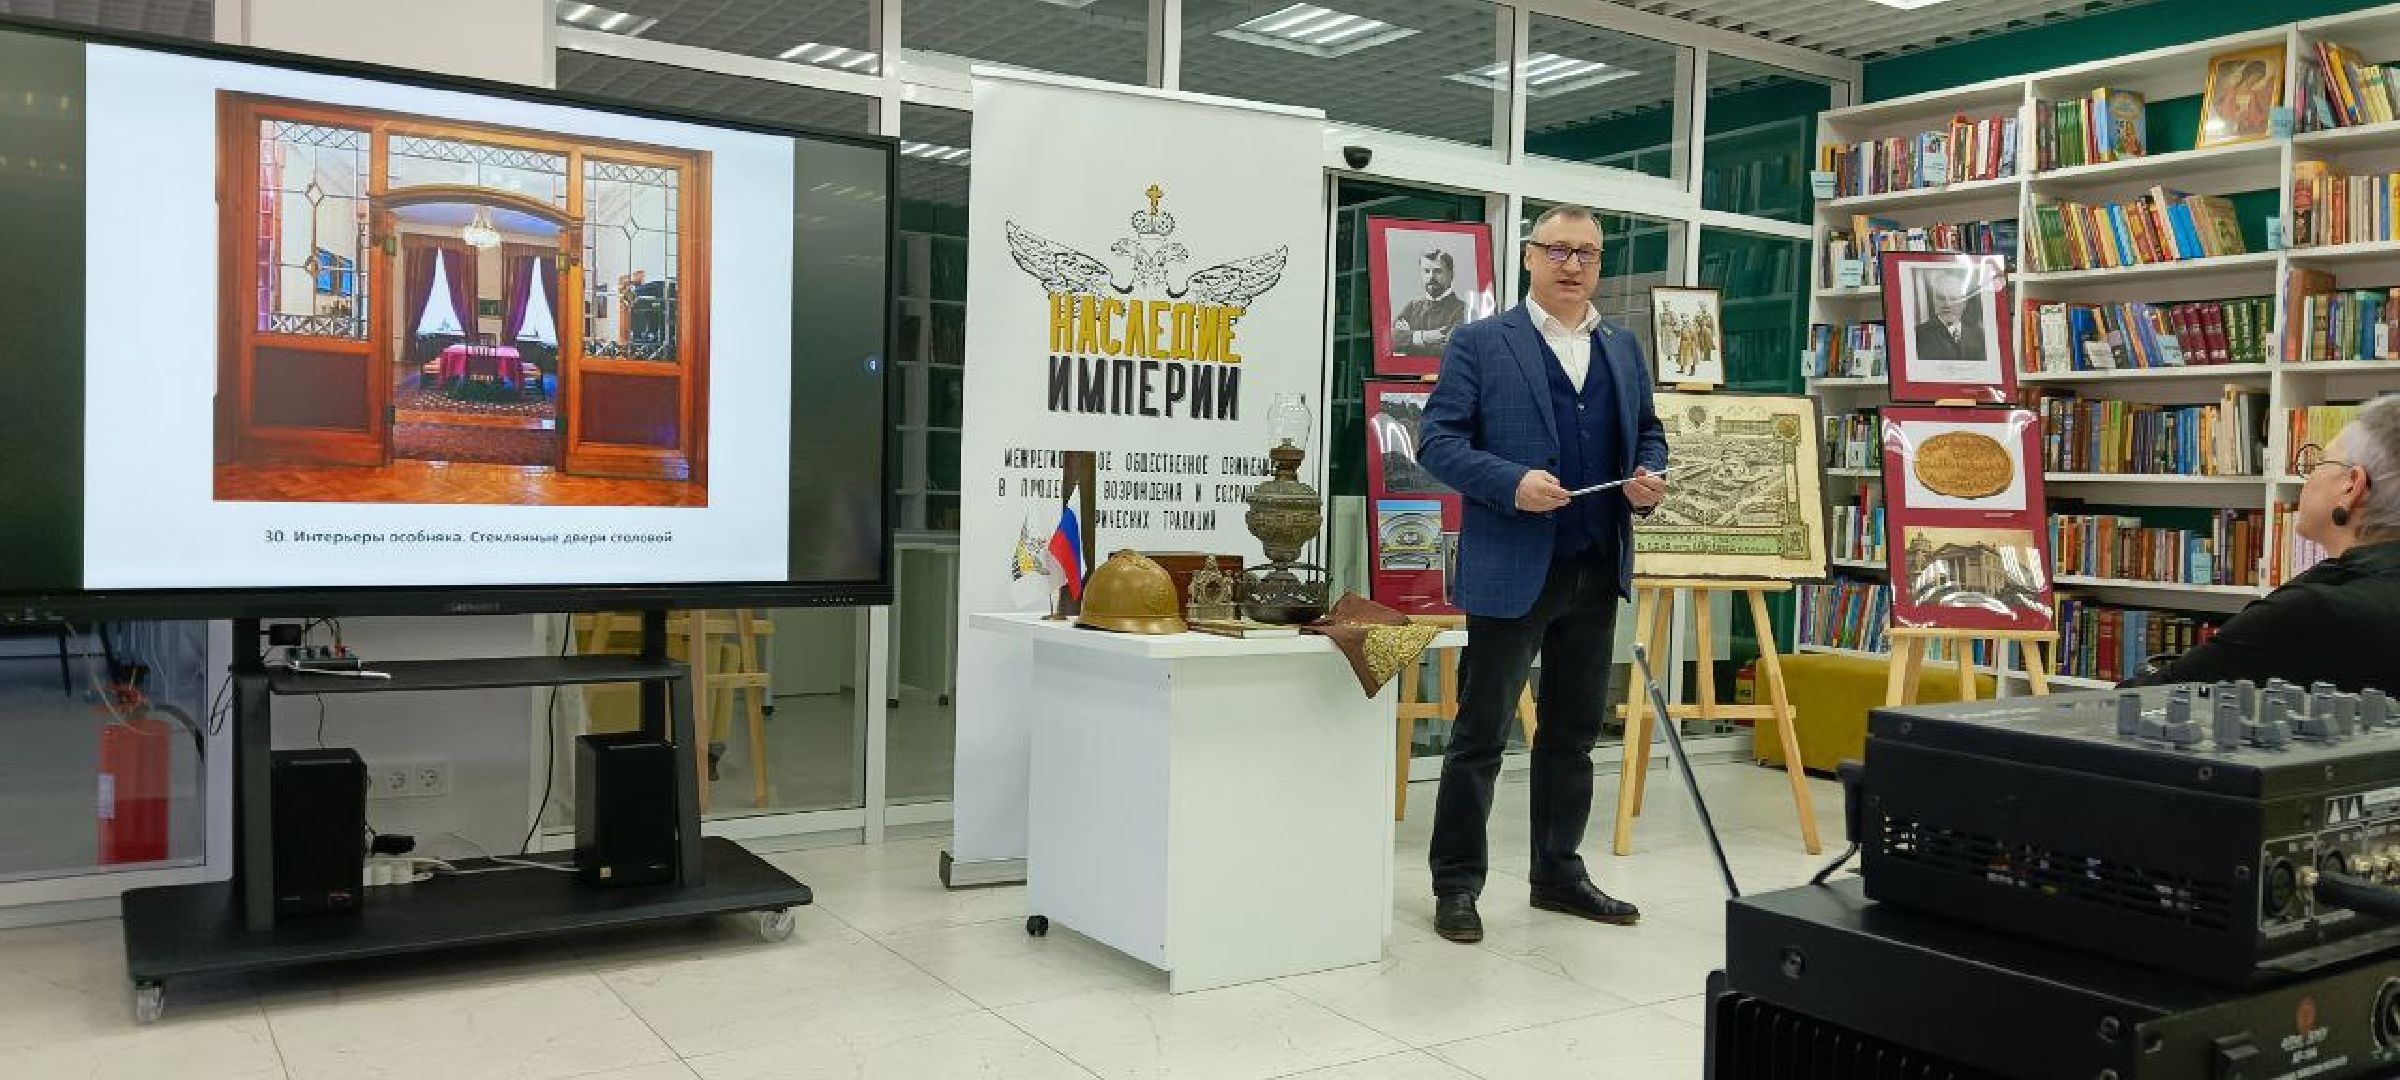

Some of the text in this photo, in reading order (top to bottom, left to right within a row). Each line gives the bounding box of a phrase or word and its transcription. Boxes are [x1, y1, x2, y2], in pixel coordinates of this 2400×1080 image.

[1050, 293, 1243, 363] НАСЛЕДИЕ
[1048, 355, 1240, 421] ИМПЕРИИ
[1125, 452, 1208, 475] ОБЩЕСТВЕННОЕ
[998, 477, 1006, 497] В
[1103, 480, 1182, 501] ВОЗРОЖДЕНИЯ
[1195, 482, 1202, 503] И
[1215, 484, 1255, 503] СОХРАН
[1095, 509, 1216, 531] РИЧЕСКИХ ТРАДИЦИЙ
[264, 529, 674, 545] 30. Интерьеры особняка. Стеклянные двери столовой
